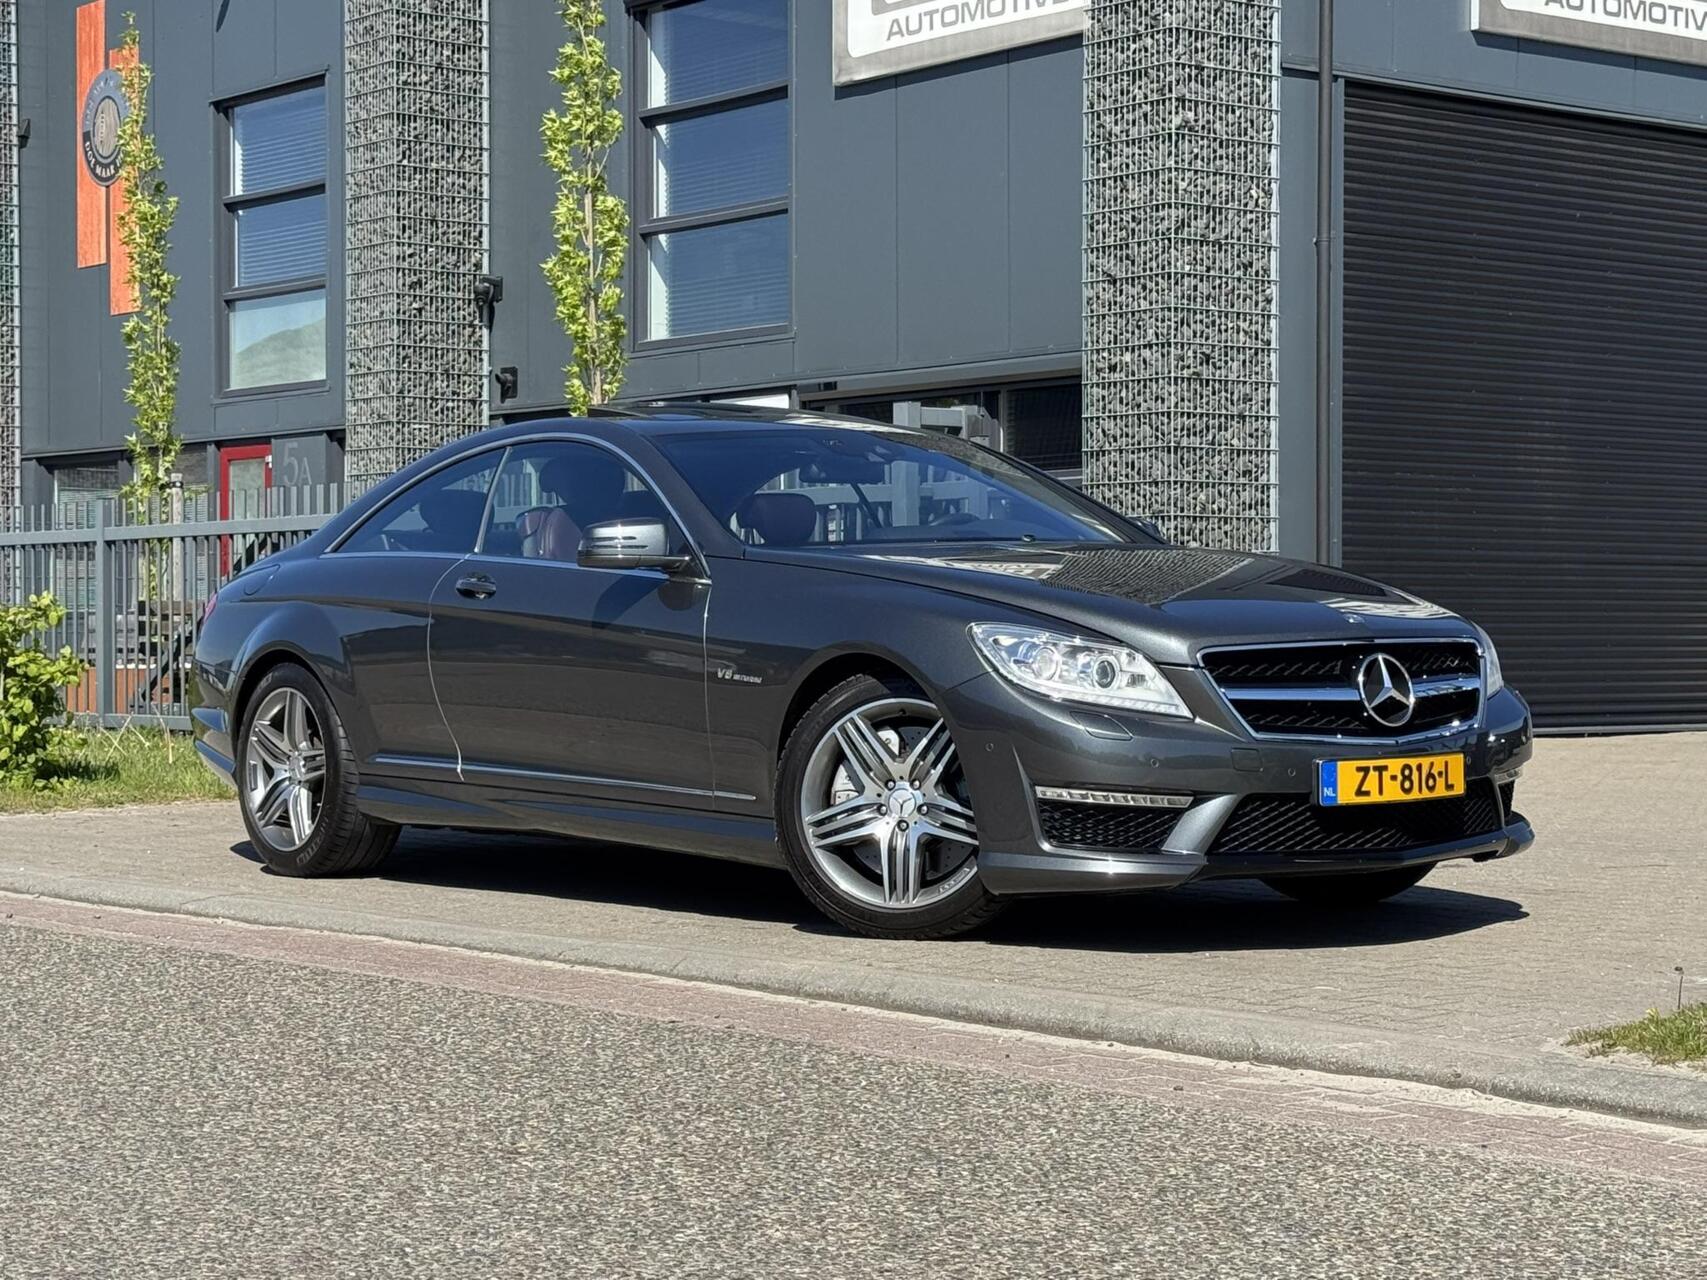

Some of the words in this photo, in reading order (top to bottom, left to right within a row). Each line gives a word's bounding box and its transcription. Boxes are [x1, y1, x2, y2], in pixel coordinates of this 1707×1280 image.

[886, 0, 1069, 41] AUTOMO
[283, 442, 312, 487] 5A
[1323, 787, 1336, 797] NL
[1354, 760, 1455, 797] ZT-816-L
